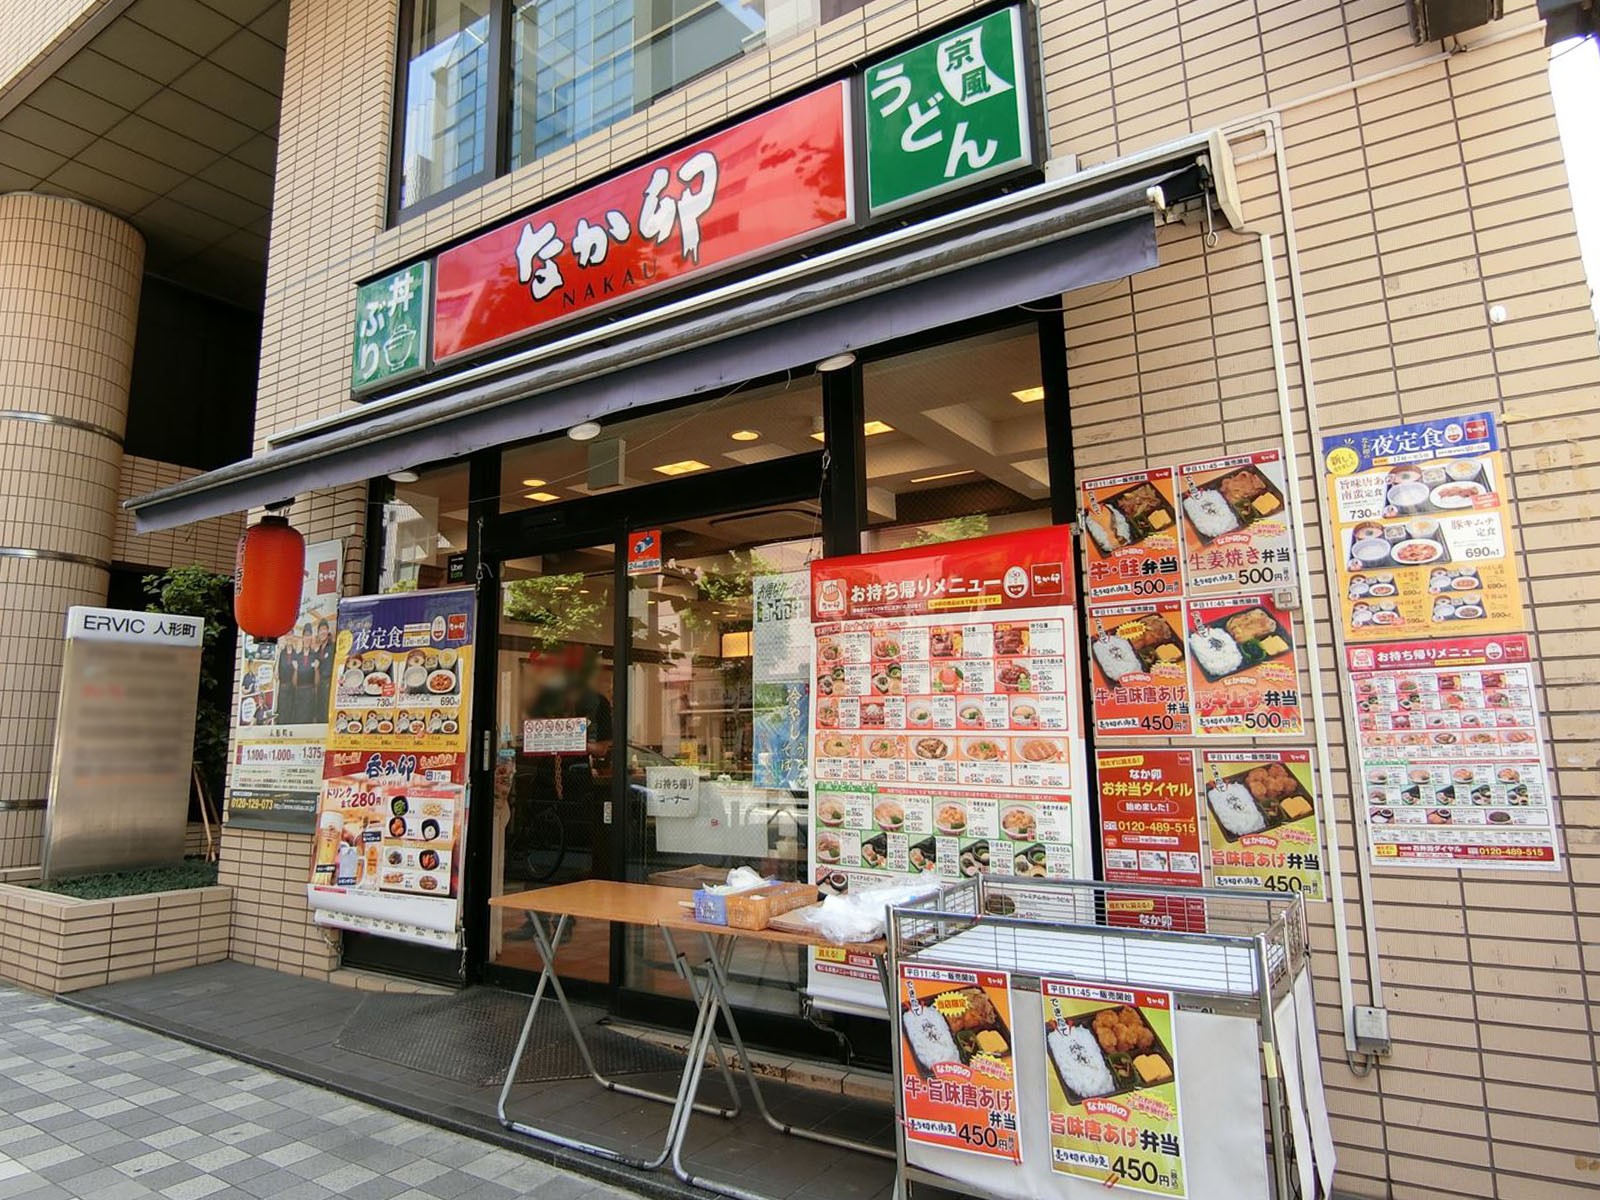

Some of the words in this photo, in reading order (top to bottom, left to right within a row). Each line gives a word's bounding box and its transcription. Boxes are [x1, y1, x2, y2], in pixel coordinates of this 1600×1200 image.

[945, 37, 991, 102] 京風
[870, 63, 998, 178] うどん
[562, 259, 657, 309] NAKAU
[1370, 427, 1445, 456] 夜定食
[1189, 546, 1291, 572] 生姜焼き弁当
[1238, 566, 1283, 585] 500円
[850, 578, 1002, 603] お持ち帰りメニュー
[84, 615, 145, 634] ERVIC
[153, 621, 196, 638] 人形町
[353, 625, 403, 650] 夜定食
[1376, 647, 1484, 663] お持ち帰りメニュー
[1096, 685, 1186, 703] 牛・旨味唐あげ
[786, 686, 802, 740] 冷やし
[1167, 702, 1189, 714] 弁当
[1141, 715, 1181, 731] 450円
[654, 778, 695, 790] お持ち帰り
[1129, 768, 1162, 779] なか卯
[326, 786, 353, 800] ドリンク
[1102, 781, 1193, 797] お弁当ダイヤル
[1118, 821, 1196, 833] 0120-489-515
[1211, 849, 1320, 871] 旨味唐あげ弁当
[1479, 847, 1544, 857] 0120-489-515
[936, 1065, 971, 1078] なか卯の
[905, 1075, 1012, 1111] 牛・旨味唐あげ
[1087, 1102, 1127, 1117] なか卯の
[989, 1111, 1017, 1131] 弁当
[958, 1123, 1008, 1150] 450円
[1050, 1112, 1180, 1157] 旨味唐あげ弁当
[1112, 1155, 1170, 1187] 450円
